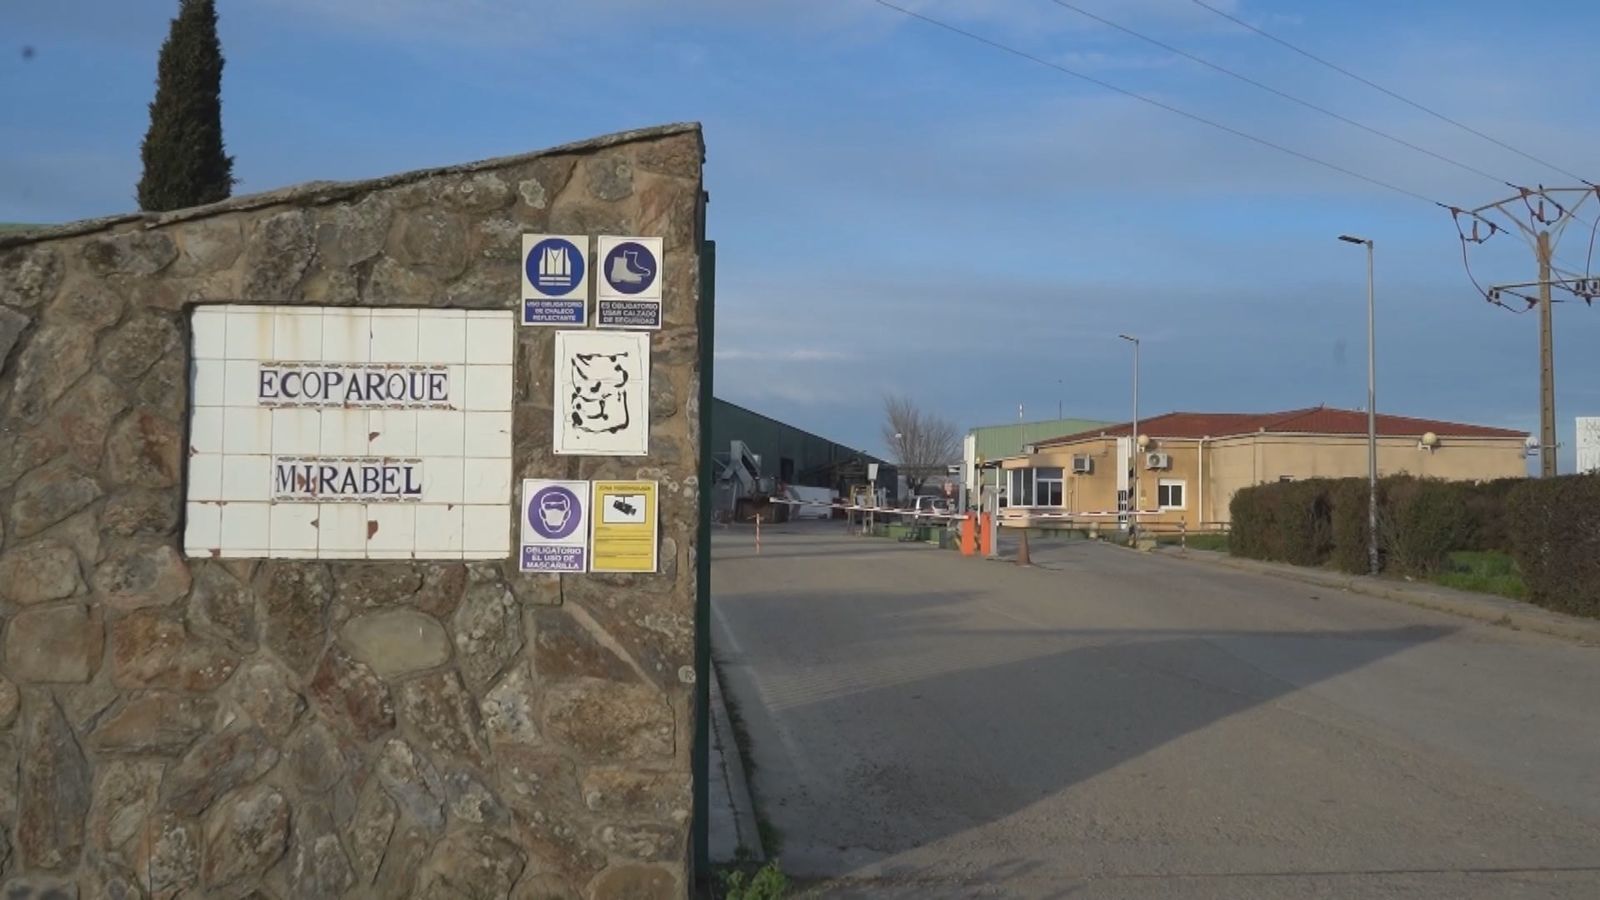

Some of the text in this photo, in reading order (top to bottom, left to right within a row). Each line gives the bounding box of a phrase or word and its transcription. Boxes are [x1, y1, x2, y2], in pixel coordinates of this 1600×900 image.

[611, 302, 658, 310] OBLIGATORIO
[623, 310, 657, 318] CALZADO
[614, 316, 656, 325] SEGURIDAD
[258, 369, 449, 401] ECOPARQUE
[275, 464, 422, 495] MIRABEL
[525, 546, 582, 555] OBLIGATORIO
[526, 561, 580, 570] MASCARILLA
